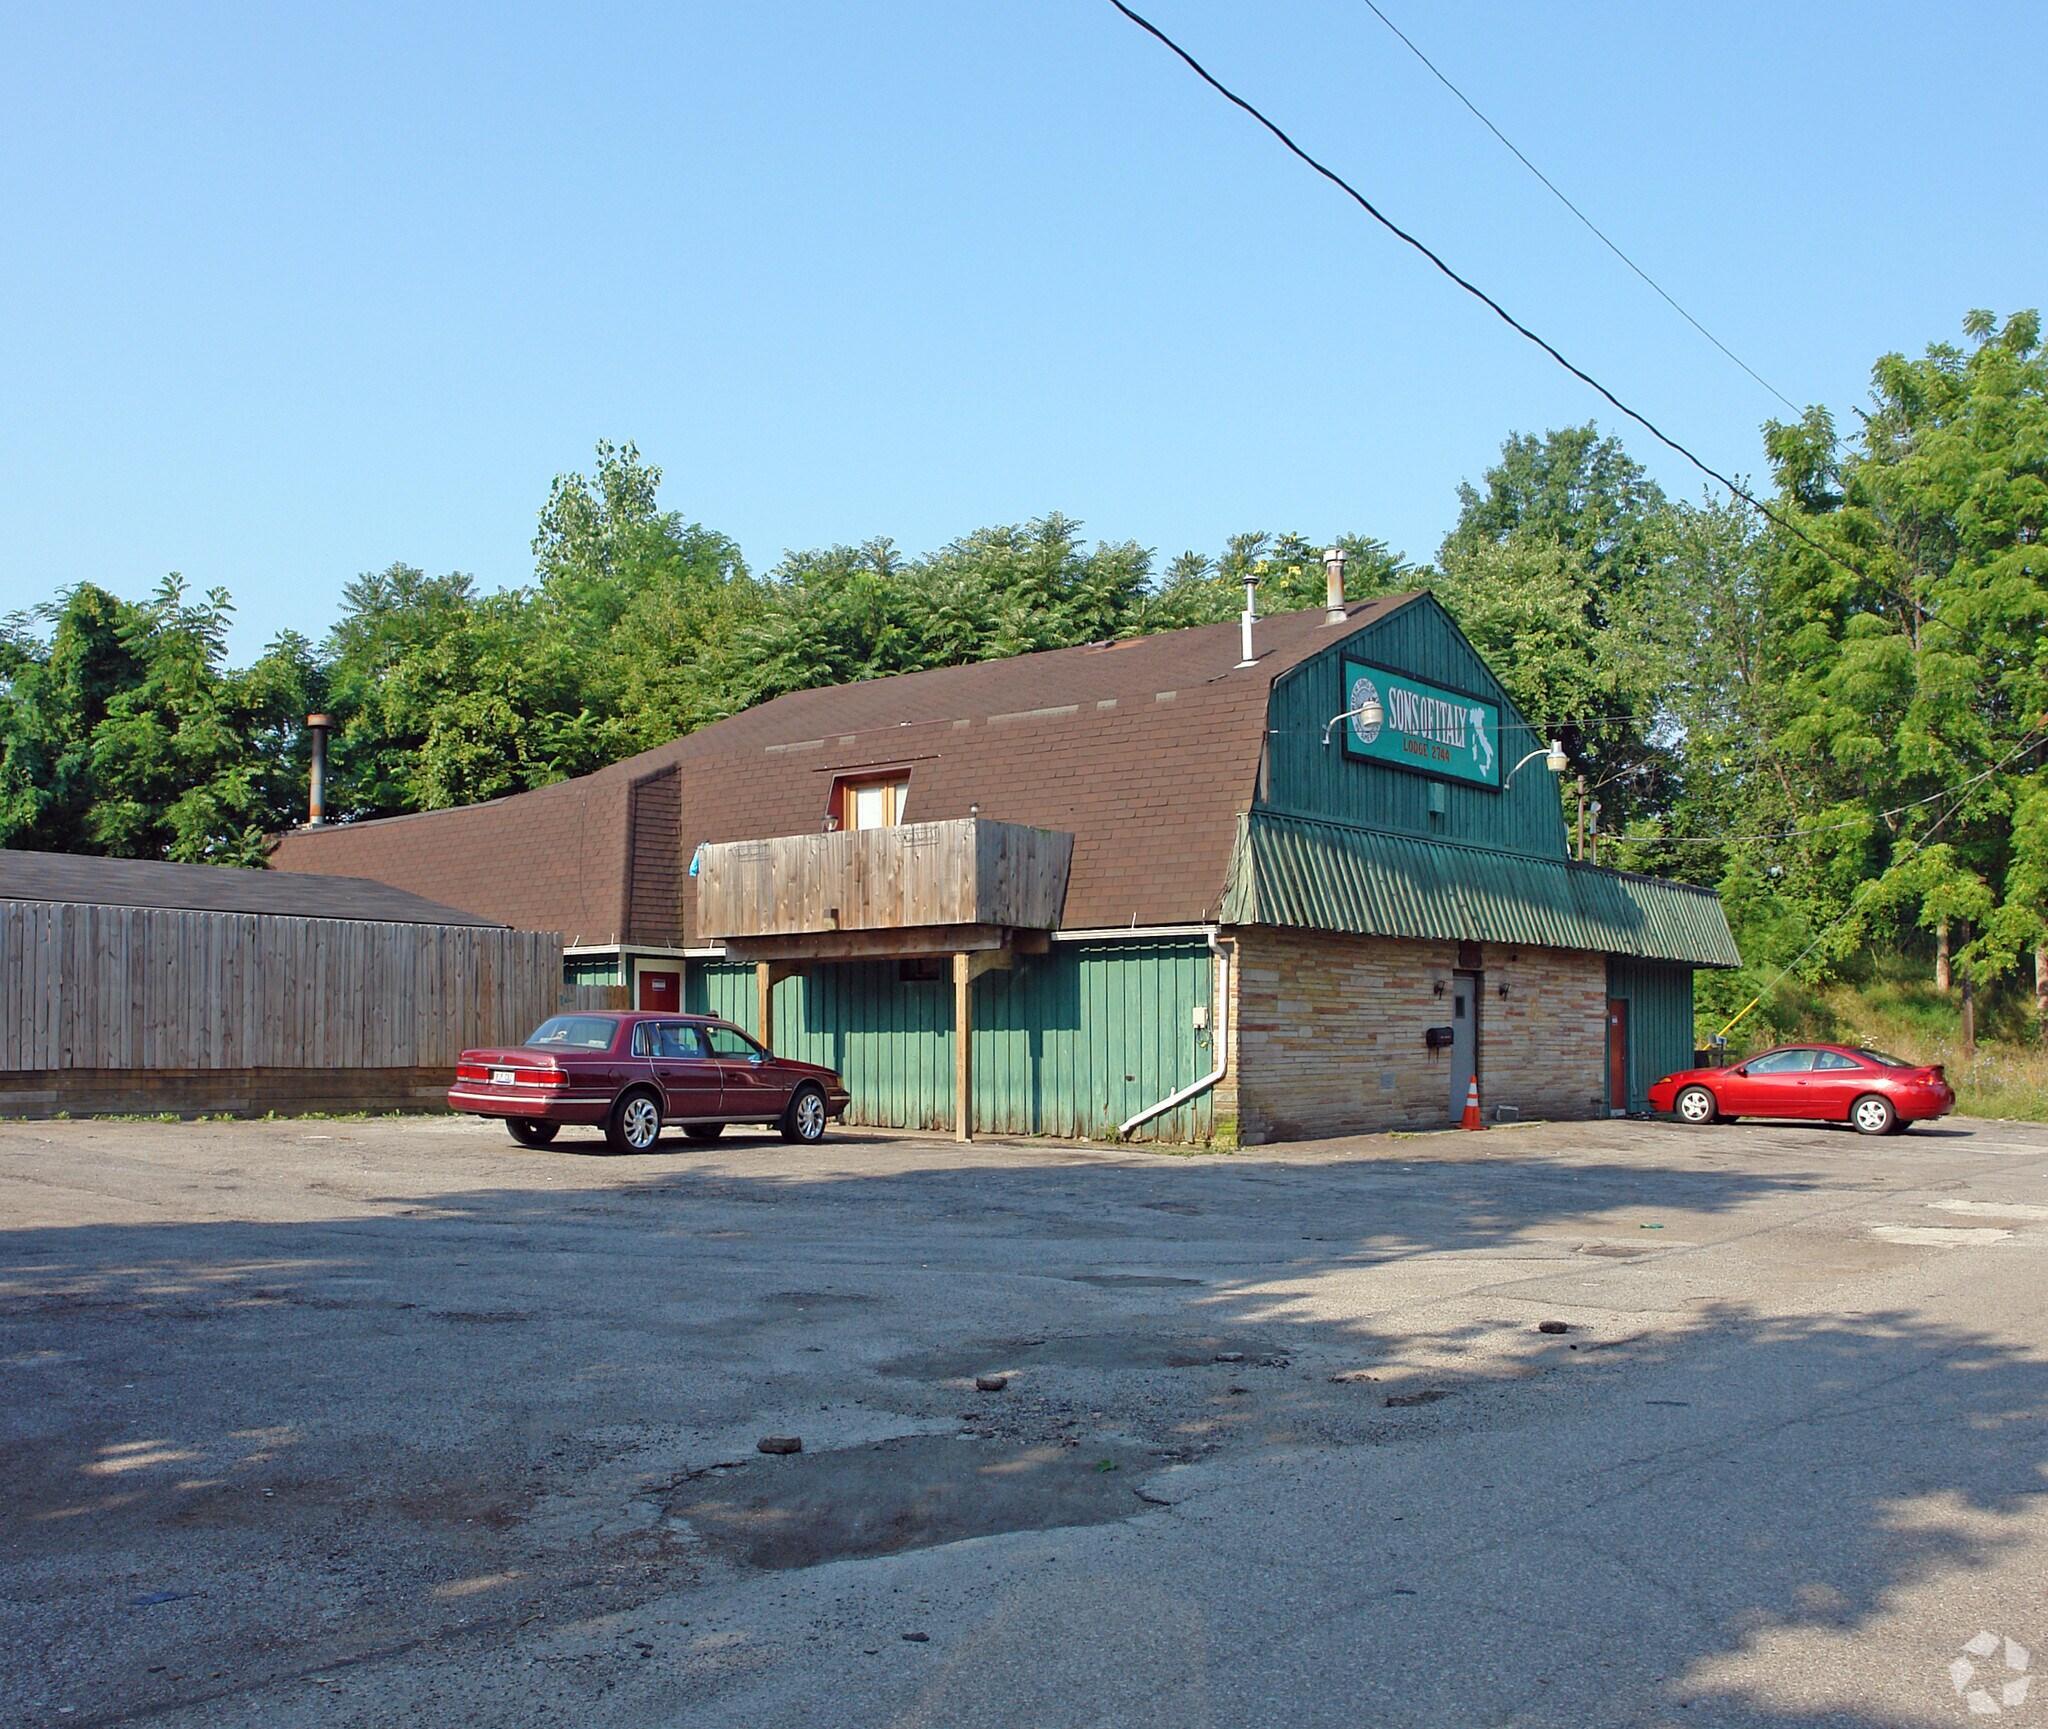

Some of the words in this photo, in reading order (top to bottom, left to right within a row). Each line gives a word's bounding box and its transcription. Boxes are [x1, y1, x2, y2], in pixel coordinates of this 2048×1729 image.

[1388, 686, 1419, 736] SONS
[1420, 696, 1435, 740] OF
[1435, 700, 1468, 749] ITALY
[1403, 738, 1428, 757] LODGE
[1432, 745, 1450, 762] 2744
